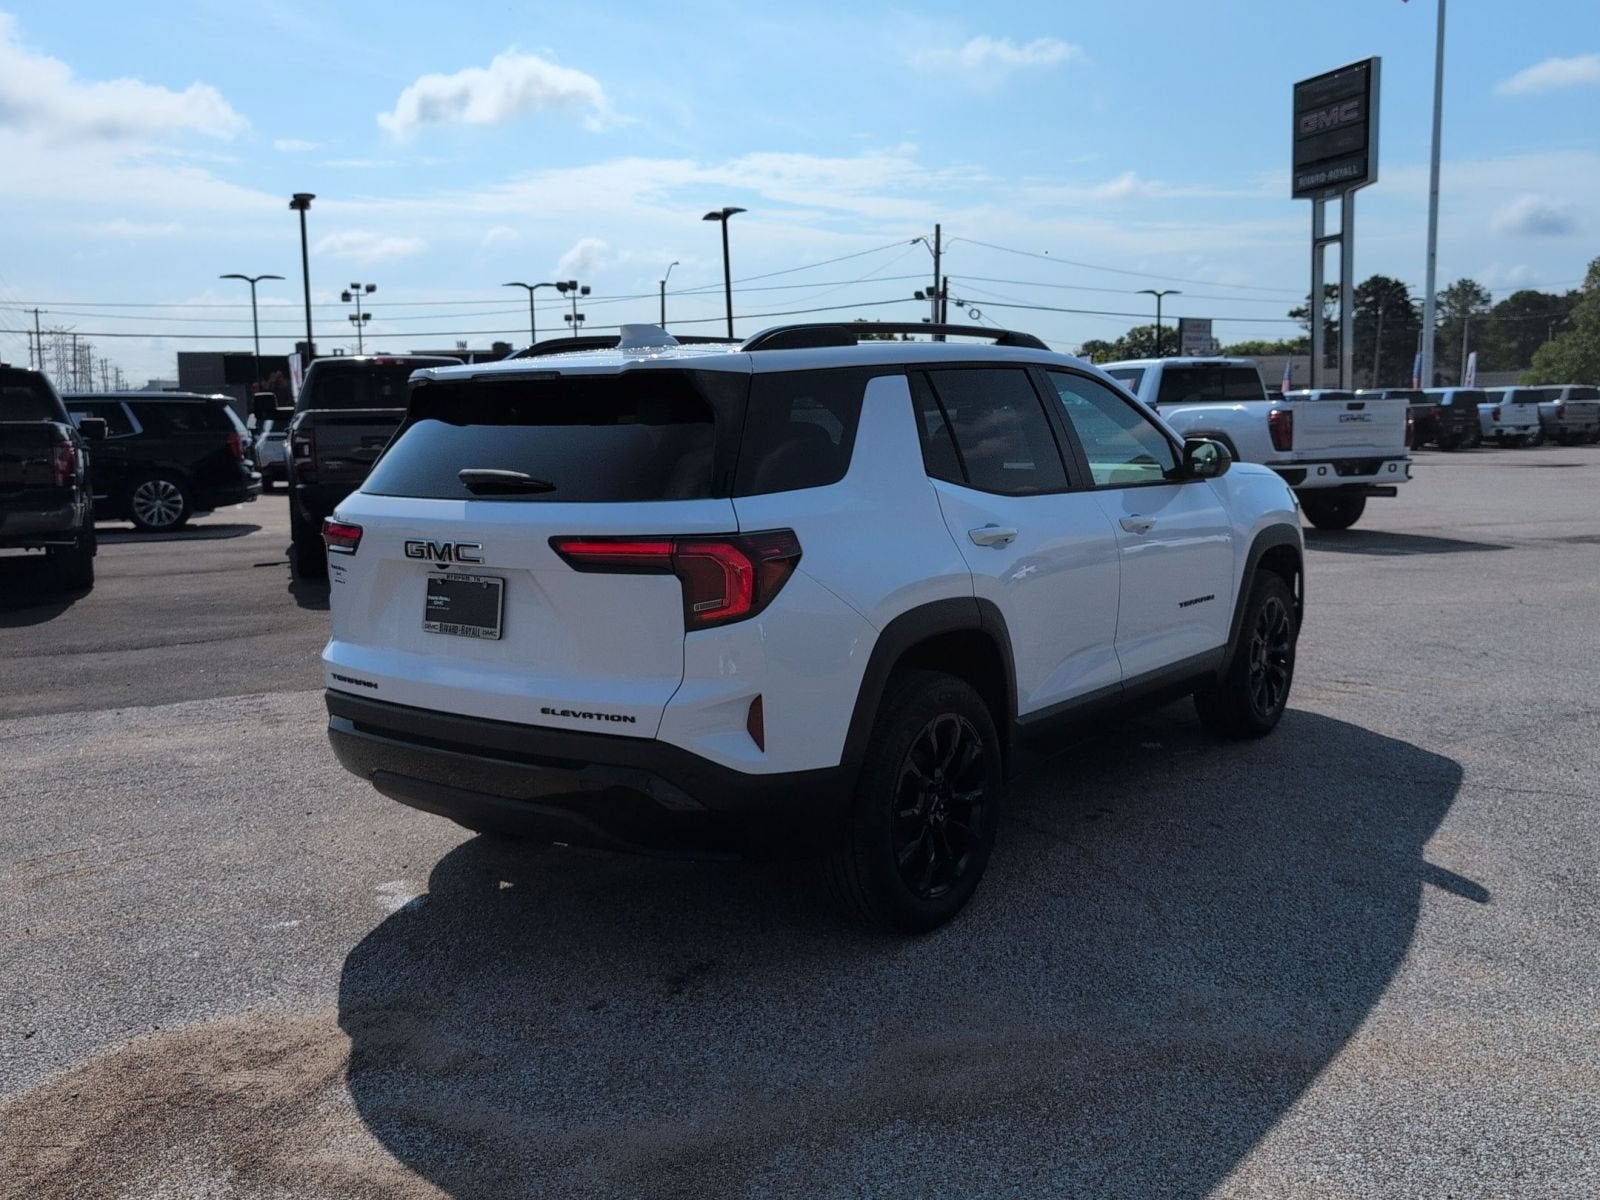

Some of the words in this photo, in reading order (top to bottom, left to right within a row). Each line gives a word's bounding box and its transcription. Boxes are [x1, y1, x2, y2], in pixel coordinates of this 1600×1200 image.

[1300, 101, 1359, 133] GMC
[405, 540, 485, 564] GMC
[540, 707, 636, 724] ELEVATION
